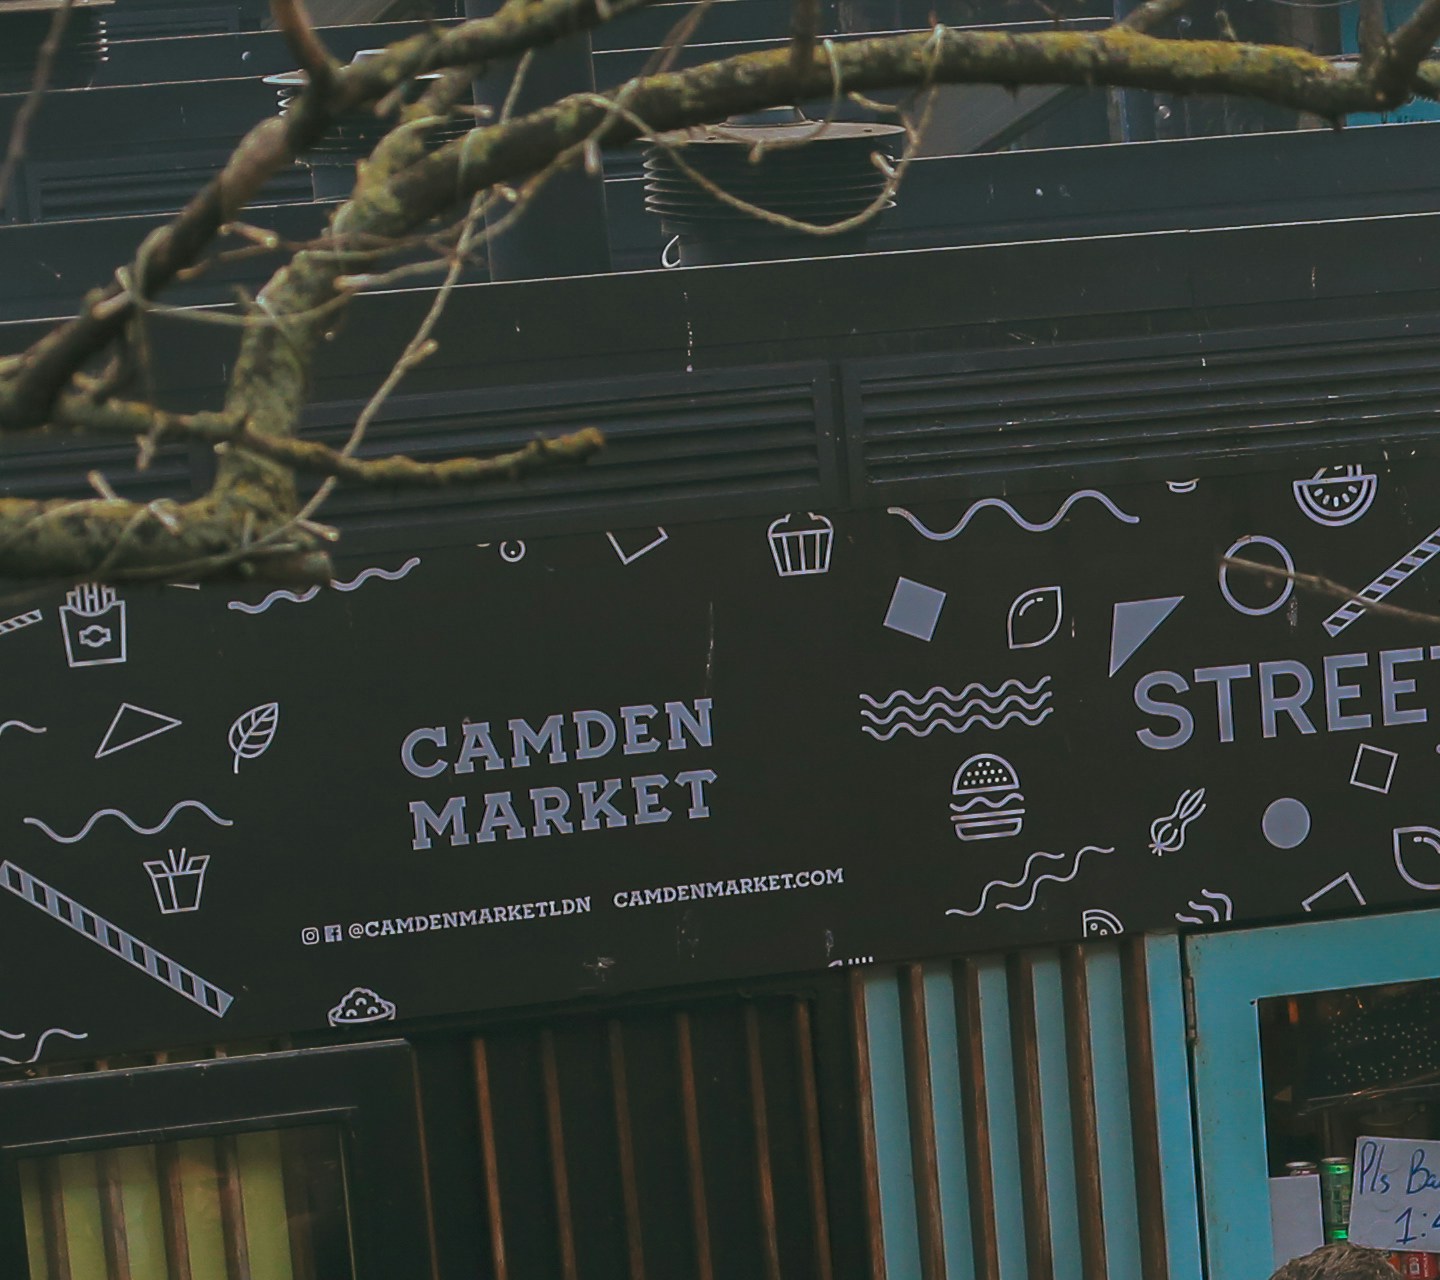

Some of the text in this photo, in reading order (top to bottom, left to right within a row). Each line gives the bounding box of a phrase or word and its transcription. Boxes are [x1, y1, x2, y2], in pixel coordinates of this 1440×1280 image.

[400, 697, 715, 779] CAMDEN
[408, 769, 717, 851] MARKET
[348, 867, 845, 941] @CAMDENMARKETLDN CAMDENMARKET.COM
[1359, 1140, 1391, 1195] Pls
